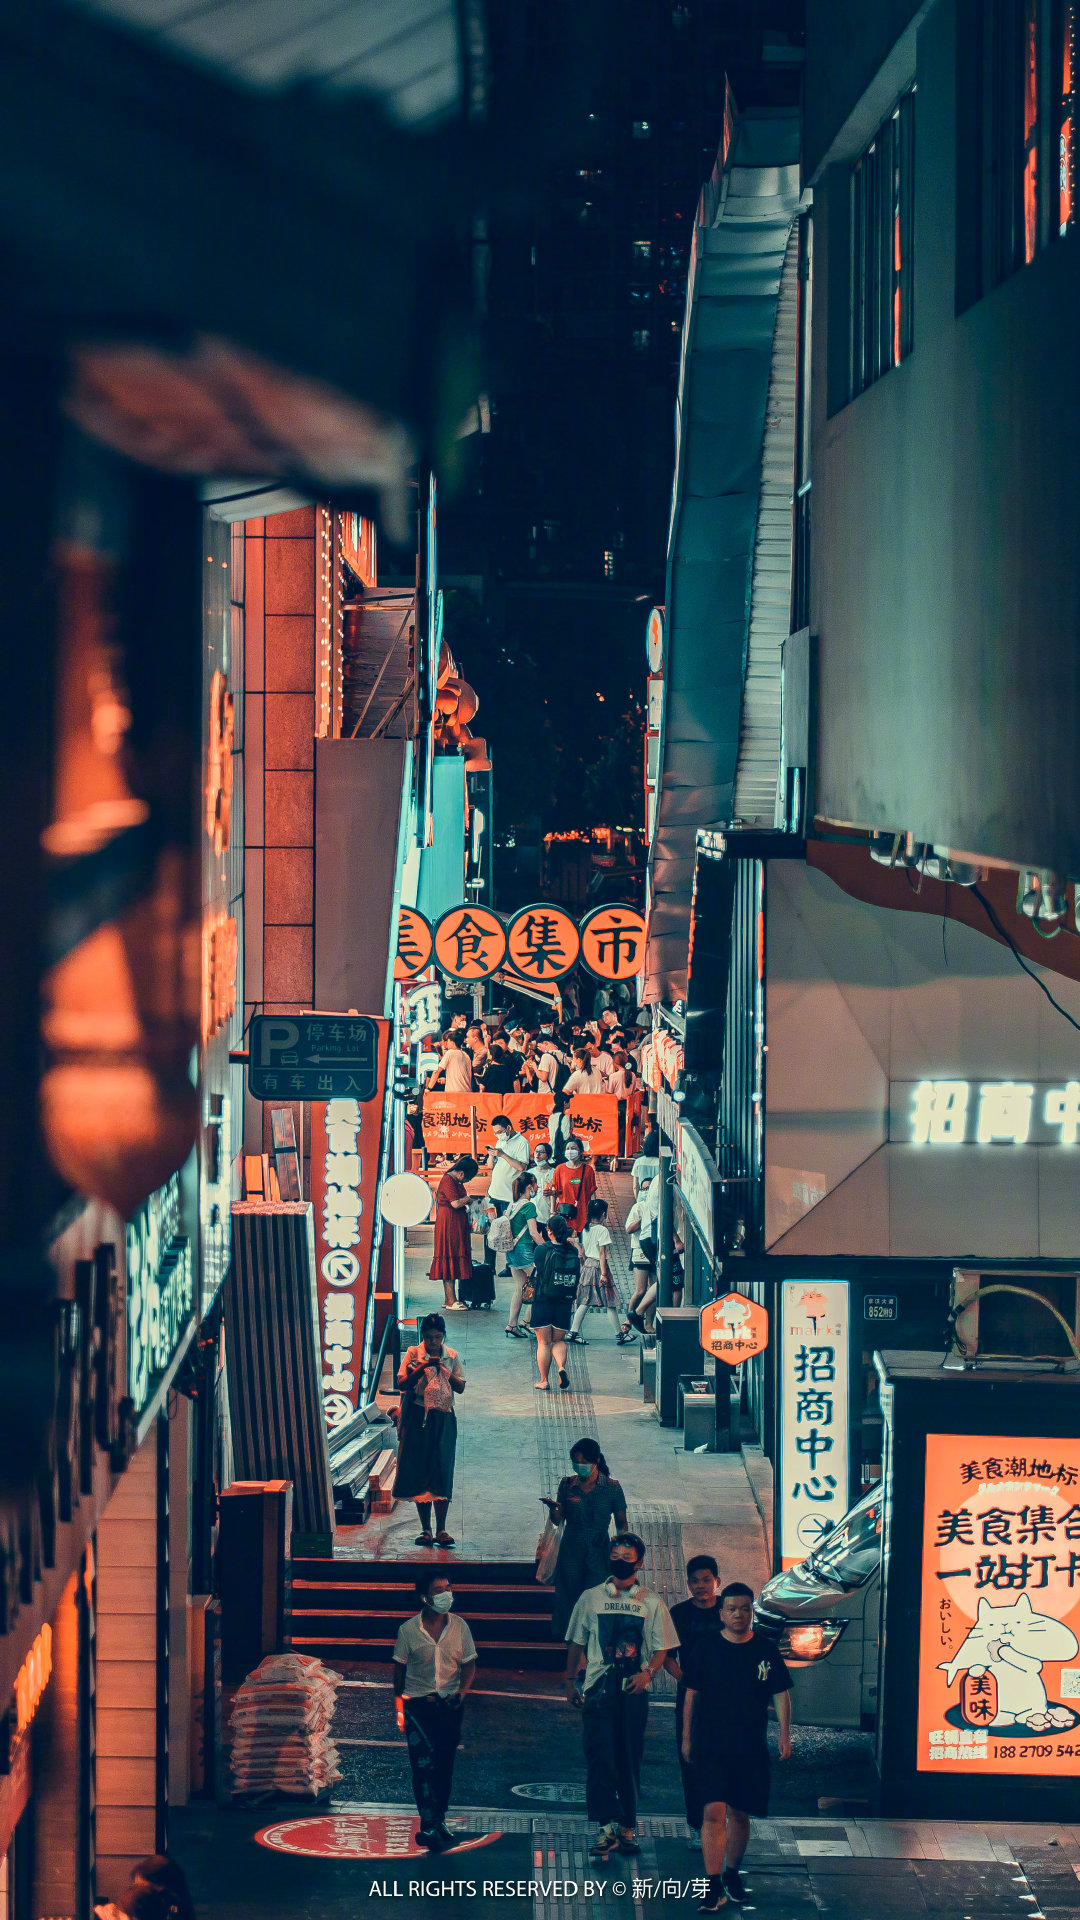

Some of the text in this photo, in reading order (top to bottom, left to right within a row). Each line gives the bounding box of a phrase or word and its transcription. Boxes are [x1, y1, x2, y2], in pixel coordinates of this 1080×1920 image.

[306, 1022, 367, 1042] 停车场
[311, 1044, 360, 1053] Parking Lot
[262, 1073, 361, 1091] 有车出入
[911, 1079, 1080, 1144] 招商中
[519, 1113, 603, 1134] 美食地标
[711, 1340, 758, 1351] 招商中心
[792, 1344, 837, 1502] 招商中心
[960, 1456, 1080, 1486] 美食潮地标
[935, 1551, 1080, 1590] 一站打卡
[604, 1602, 642, 1614] DREAM OF
[970, 1676, 995, 1720] 美味
[993, 1746, 1016, 1758] 188
[1019, 1745, 1053, 1758] 2709
